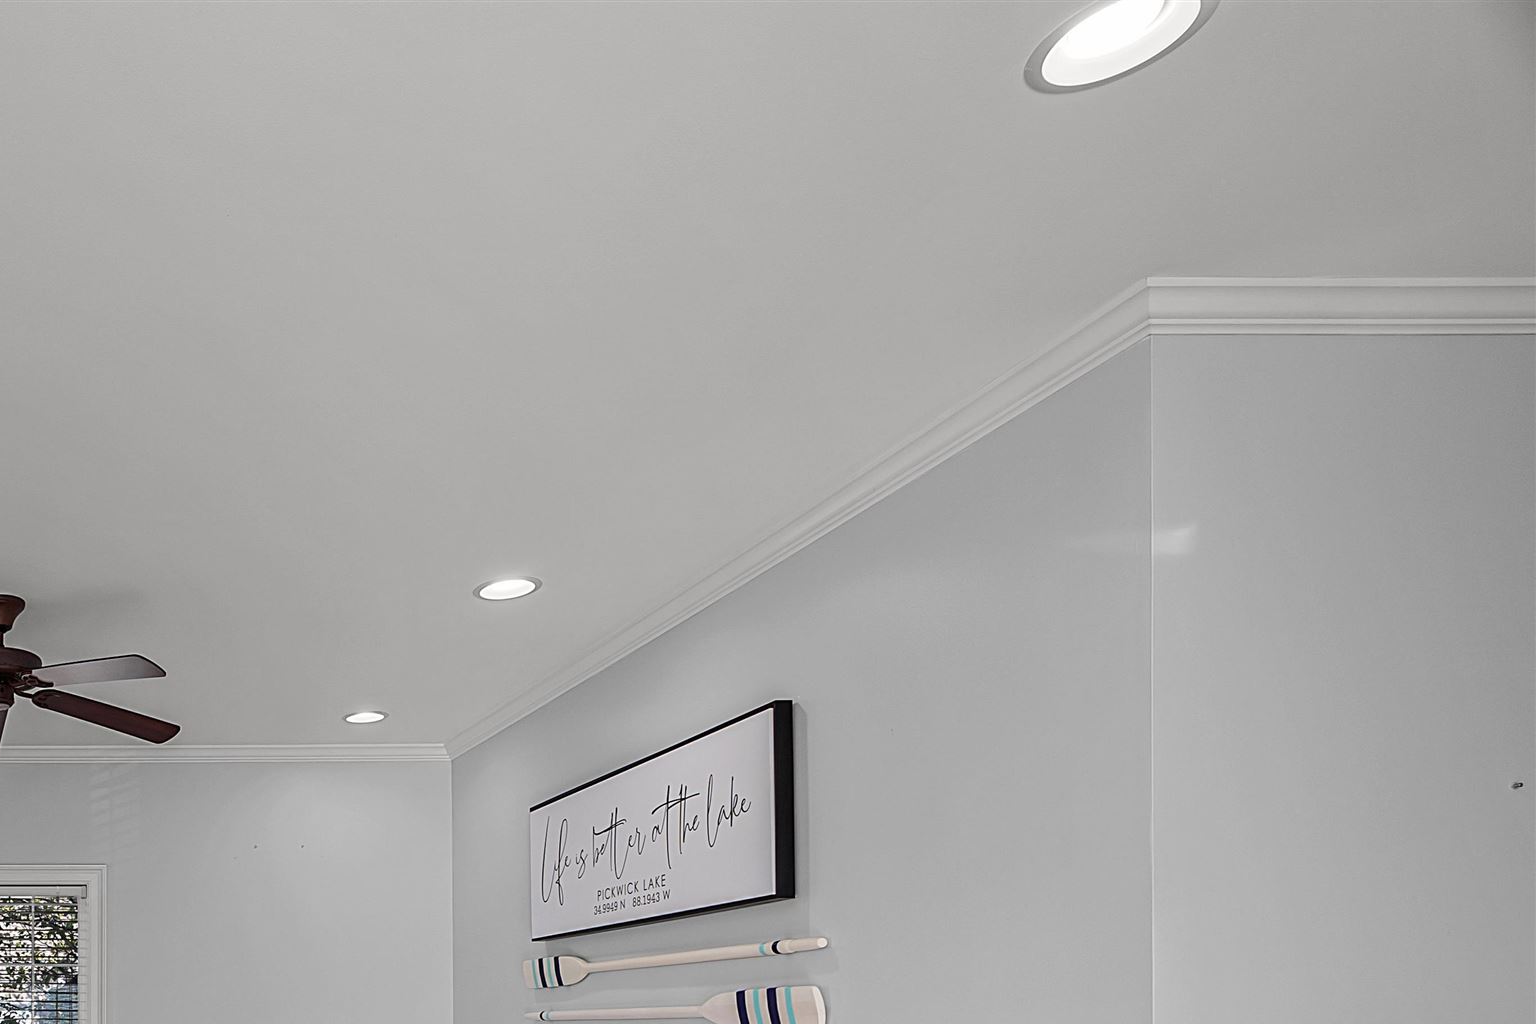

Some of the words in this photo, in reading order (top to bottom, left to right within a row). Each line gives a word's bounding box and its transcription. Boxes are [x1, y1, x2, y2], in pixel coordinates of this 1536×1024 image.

[541, 815, 572, 906] Life
[576, 849, 588, 879] is
[592, 807, 646, 880] better
[676, 783, 700, 855] the
[707, 774, 752, 848] lake
[596, 880, 640, 902] PICKWICK
[642, 873, 667, 892] LAKE
[619, 899, 626, 911] N
[662, 889, 671, 901] W
